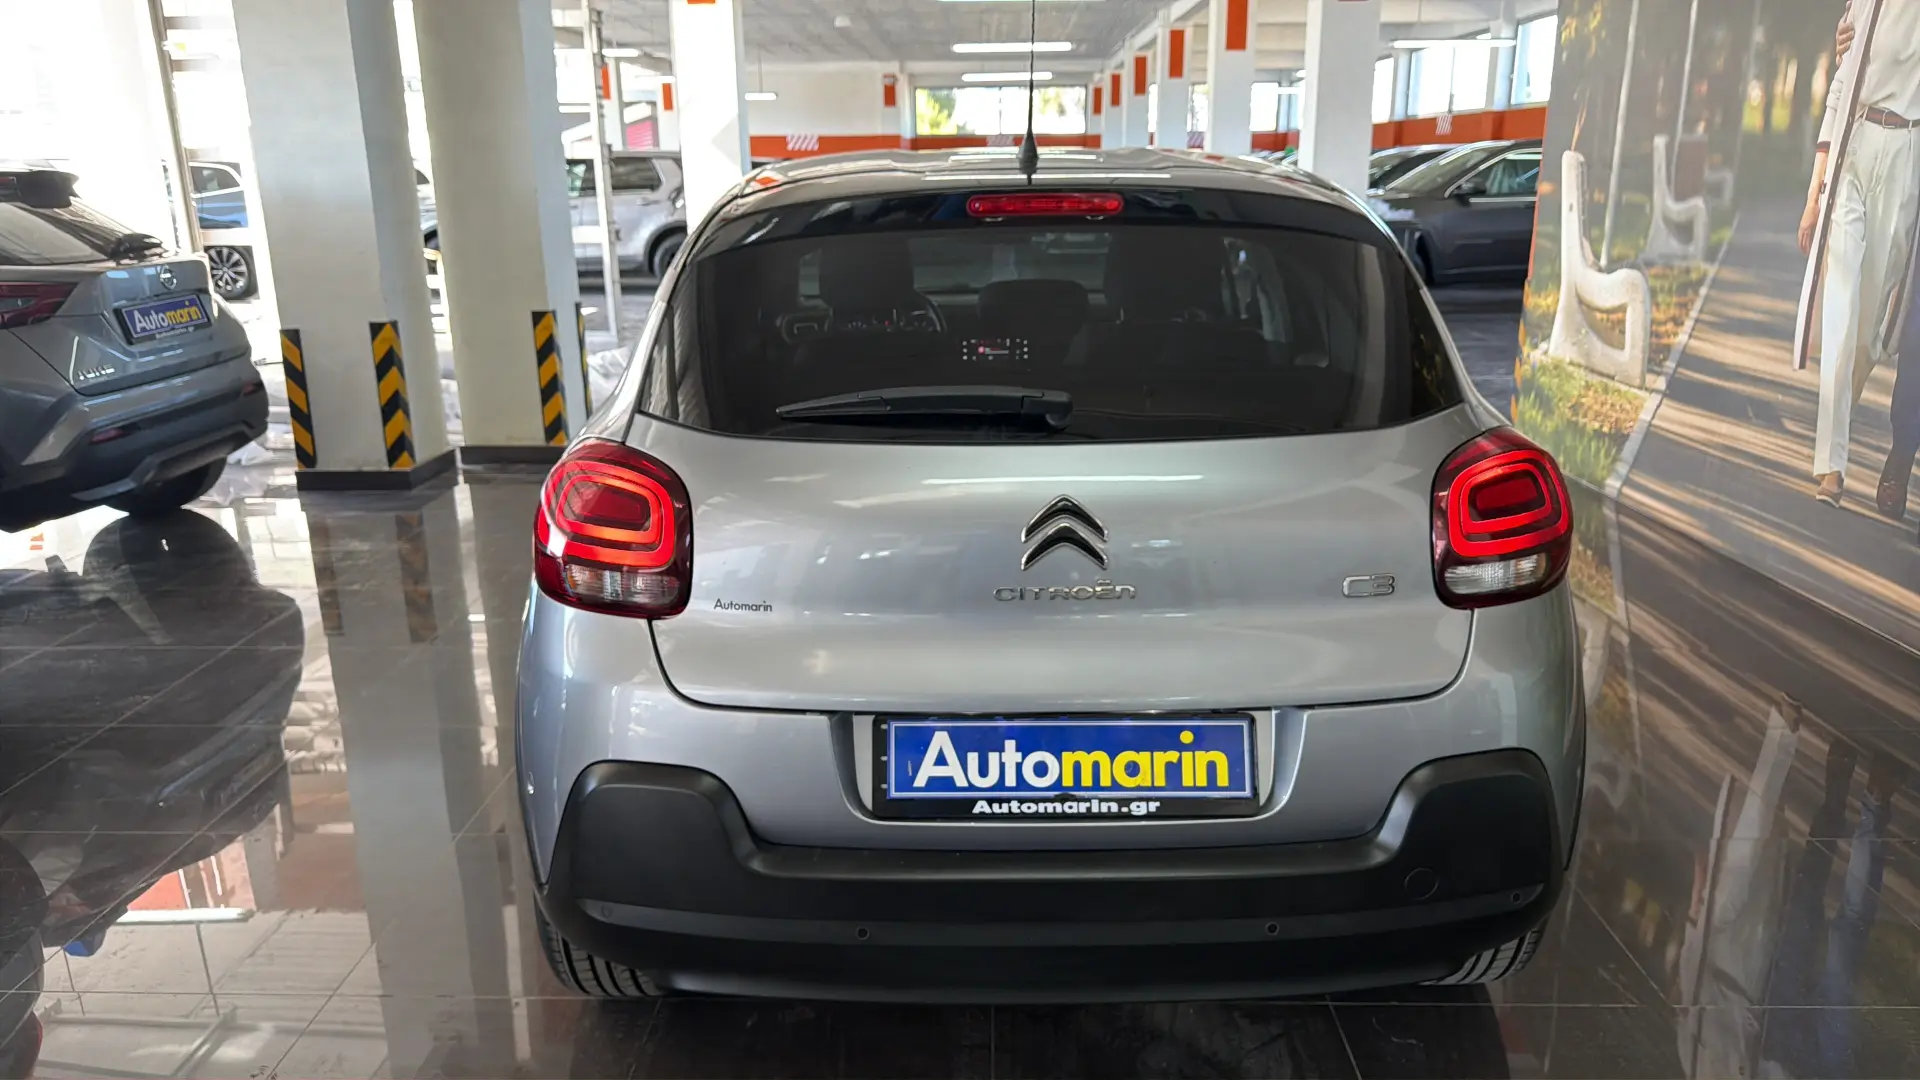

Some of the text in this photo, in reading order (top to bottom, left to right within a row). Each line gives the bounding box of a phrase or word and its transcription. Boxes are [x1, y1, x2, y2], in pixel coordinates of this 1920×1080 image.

[133, 301, 201, 332] Automarin
[1342, 573, 1395, 598] C3
[713, 598, 772, 612] Automarin
[912, 731, 1229, 788] Automarin
[972, 799, 1161, 815] Automarin.gr
